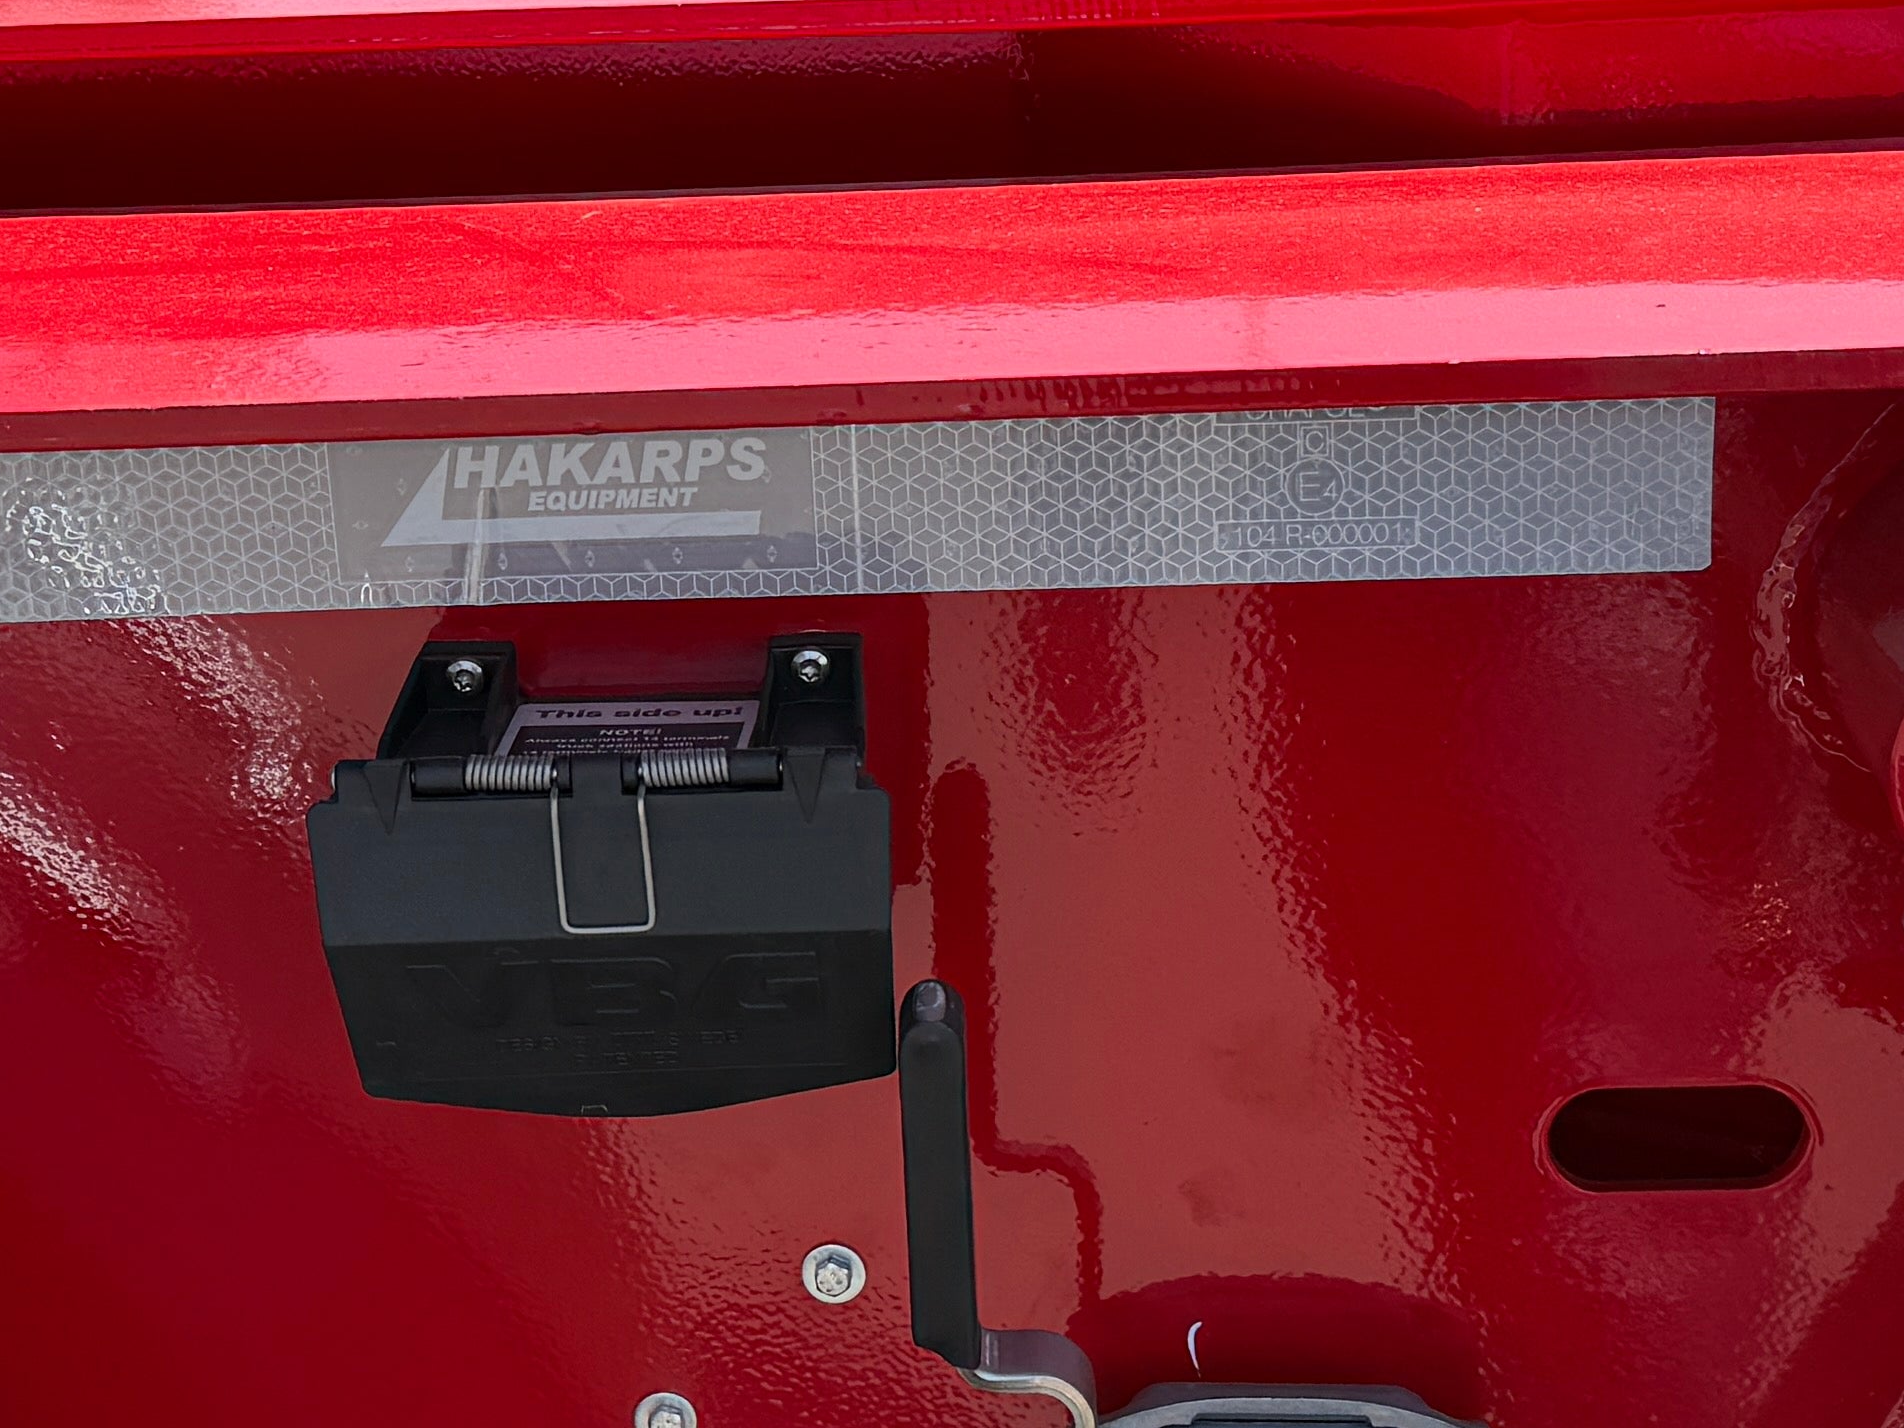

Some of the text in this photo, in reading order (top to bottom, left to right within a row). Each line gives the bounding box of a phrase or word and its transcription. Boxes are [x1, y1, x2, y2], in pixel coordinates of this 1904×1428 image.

[453, 437, 767, 489] HAKARPS
[527, 486, 699, 512] EQUIPMENT
[1232, 525, 1276, 548] 104
[535, 706, 744, 719] This side up!
